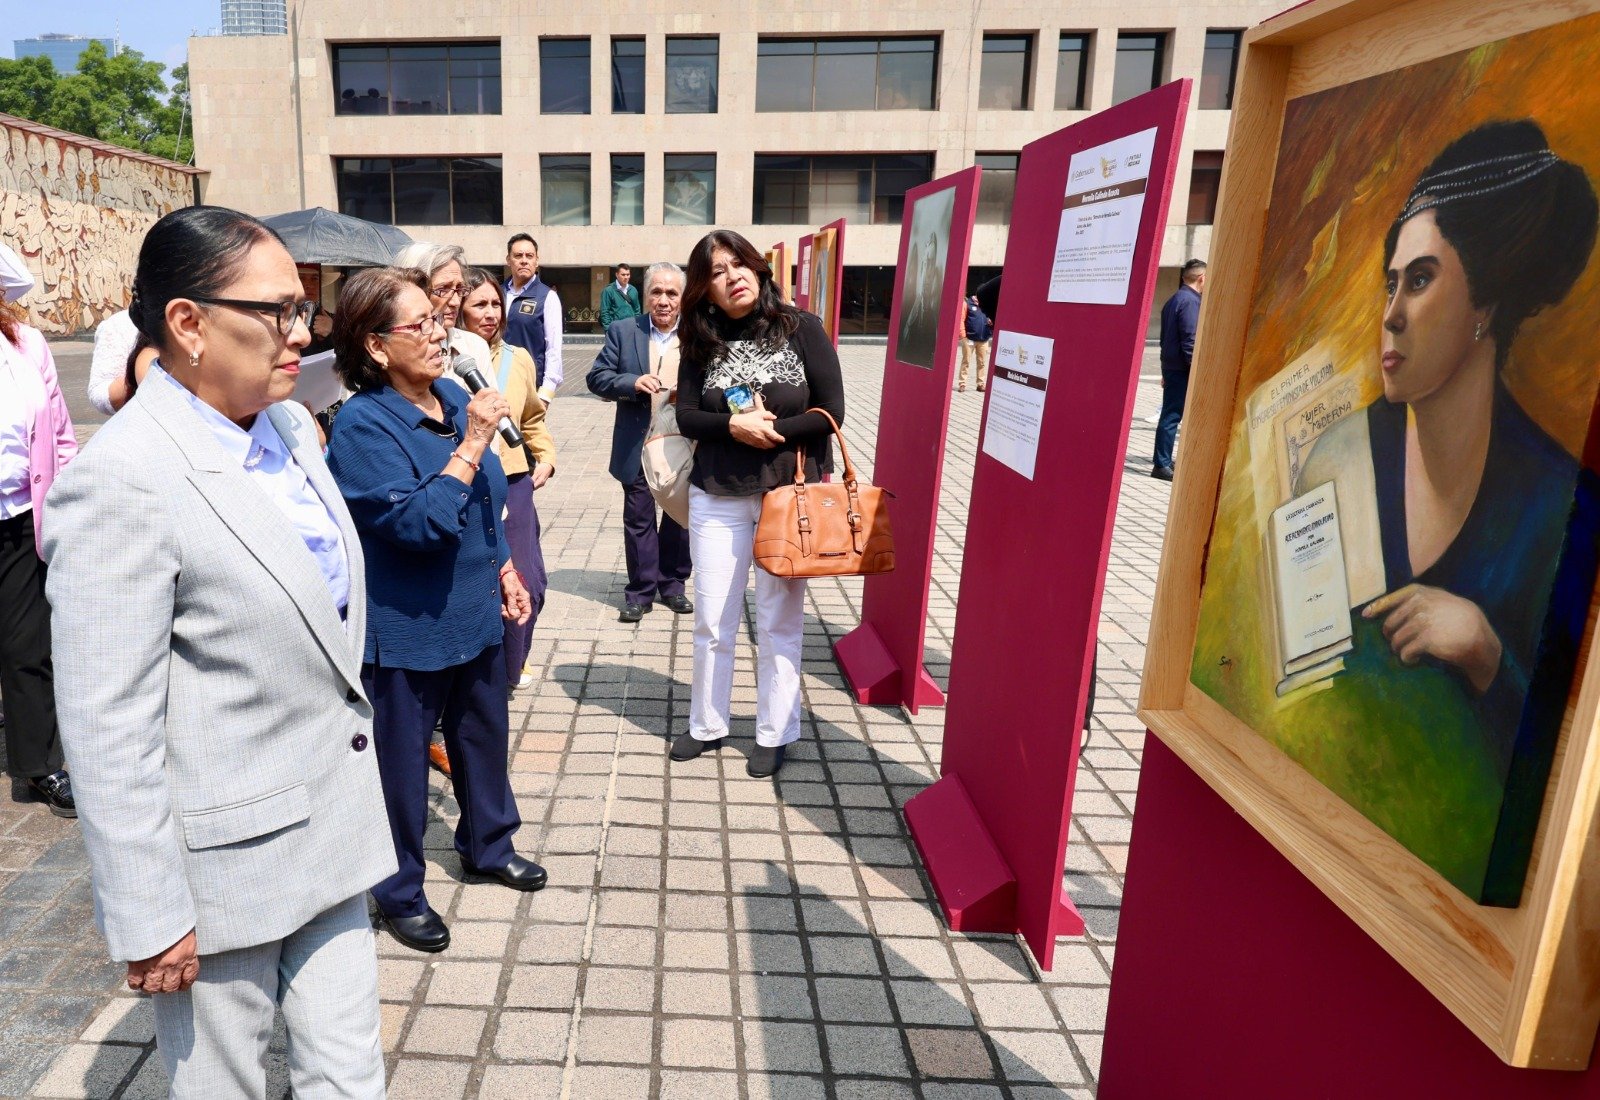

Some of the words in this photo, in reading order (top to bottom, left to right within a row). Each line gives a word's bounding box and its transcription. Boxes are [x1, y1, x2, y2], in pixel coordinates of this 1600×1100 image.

[1271, 387, 1281, 400] EL
[1281, 363, 1310, 391] PRIMER
[1300, 402, 1326, 425] MUJER
[1312, 401, 1352, 434] MODERNA
